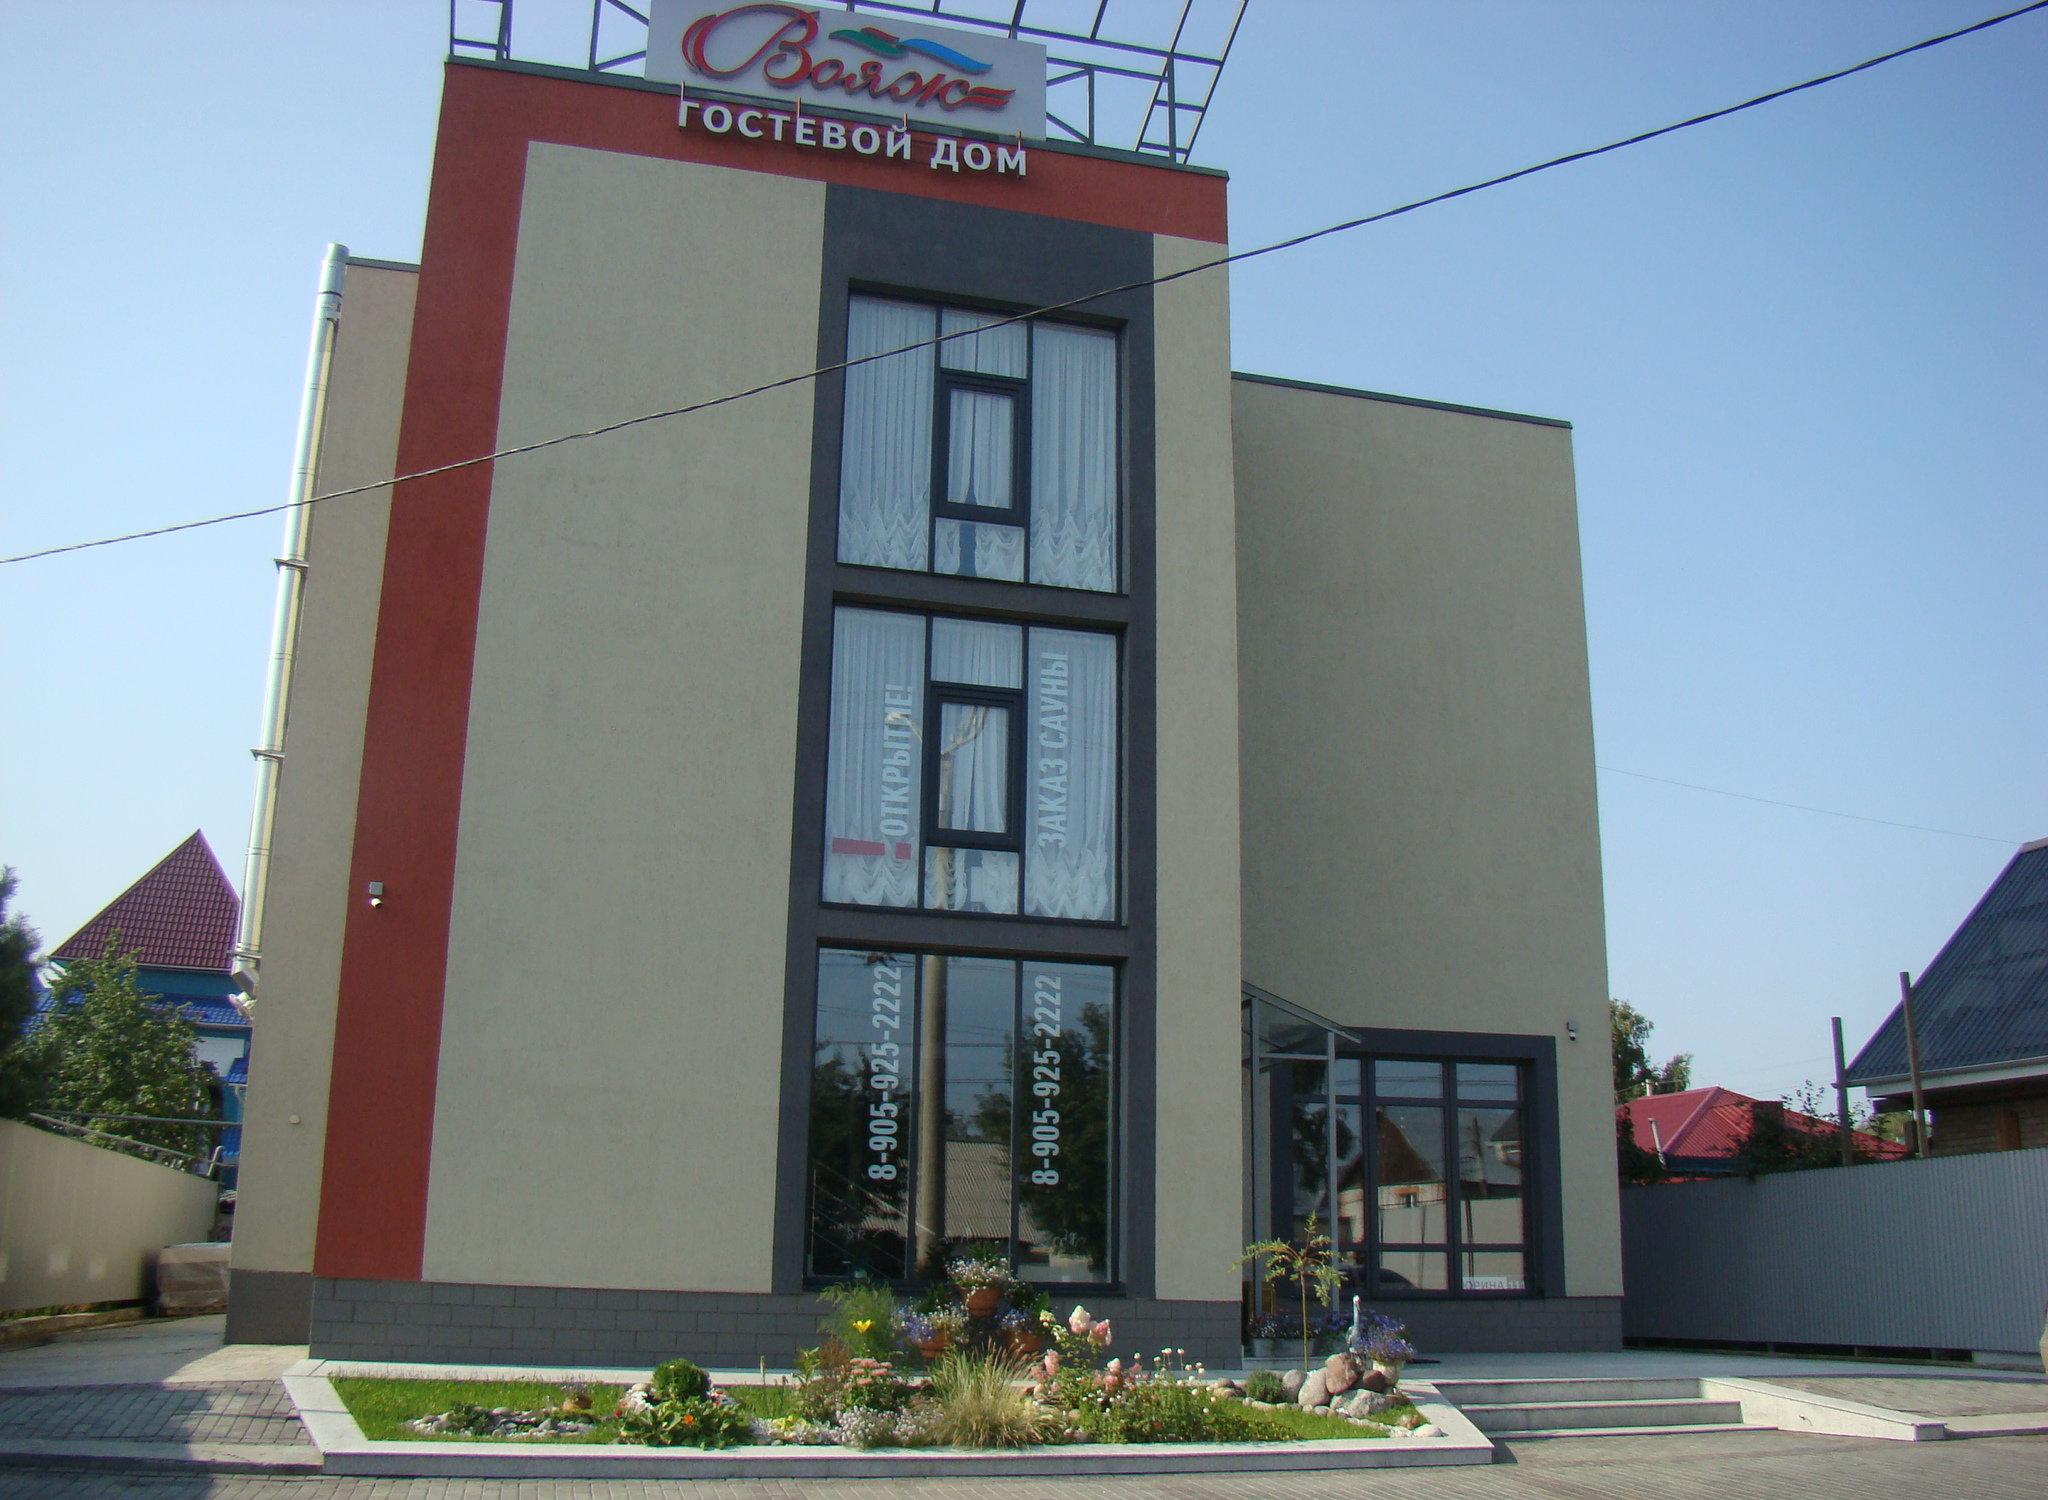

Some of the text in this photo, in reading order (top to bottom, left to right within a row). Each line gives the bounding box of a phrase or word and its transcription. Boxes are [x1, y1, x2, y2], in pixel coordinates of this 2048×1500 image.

[678, 100, 1027, 176] ГОСТЕВОЙ ДОМ
[681, 4, 1016, 112] Вояж
[1038, 652, 1069, 848] ЗАКАЗ САУНЫ
[868, 965, 902, 1181] 8-905-925-2222
[1031, 974, 1062, 1186] 8-905-925-2222
